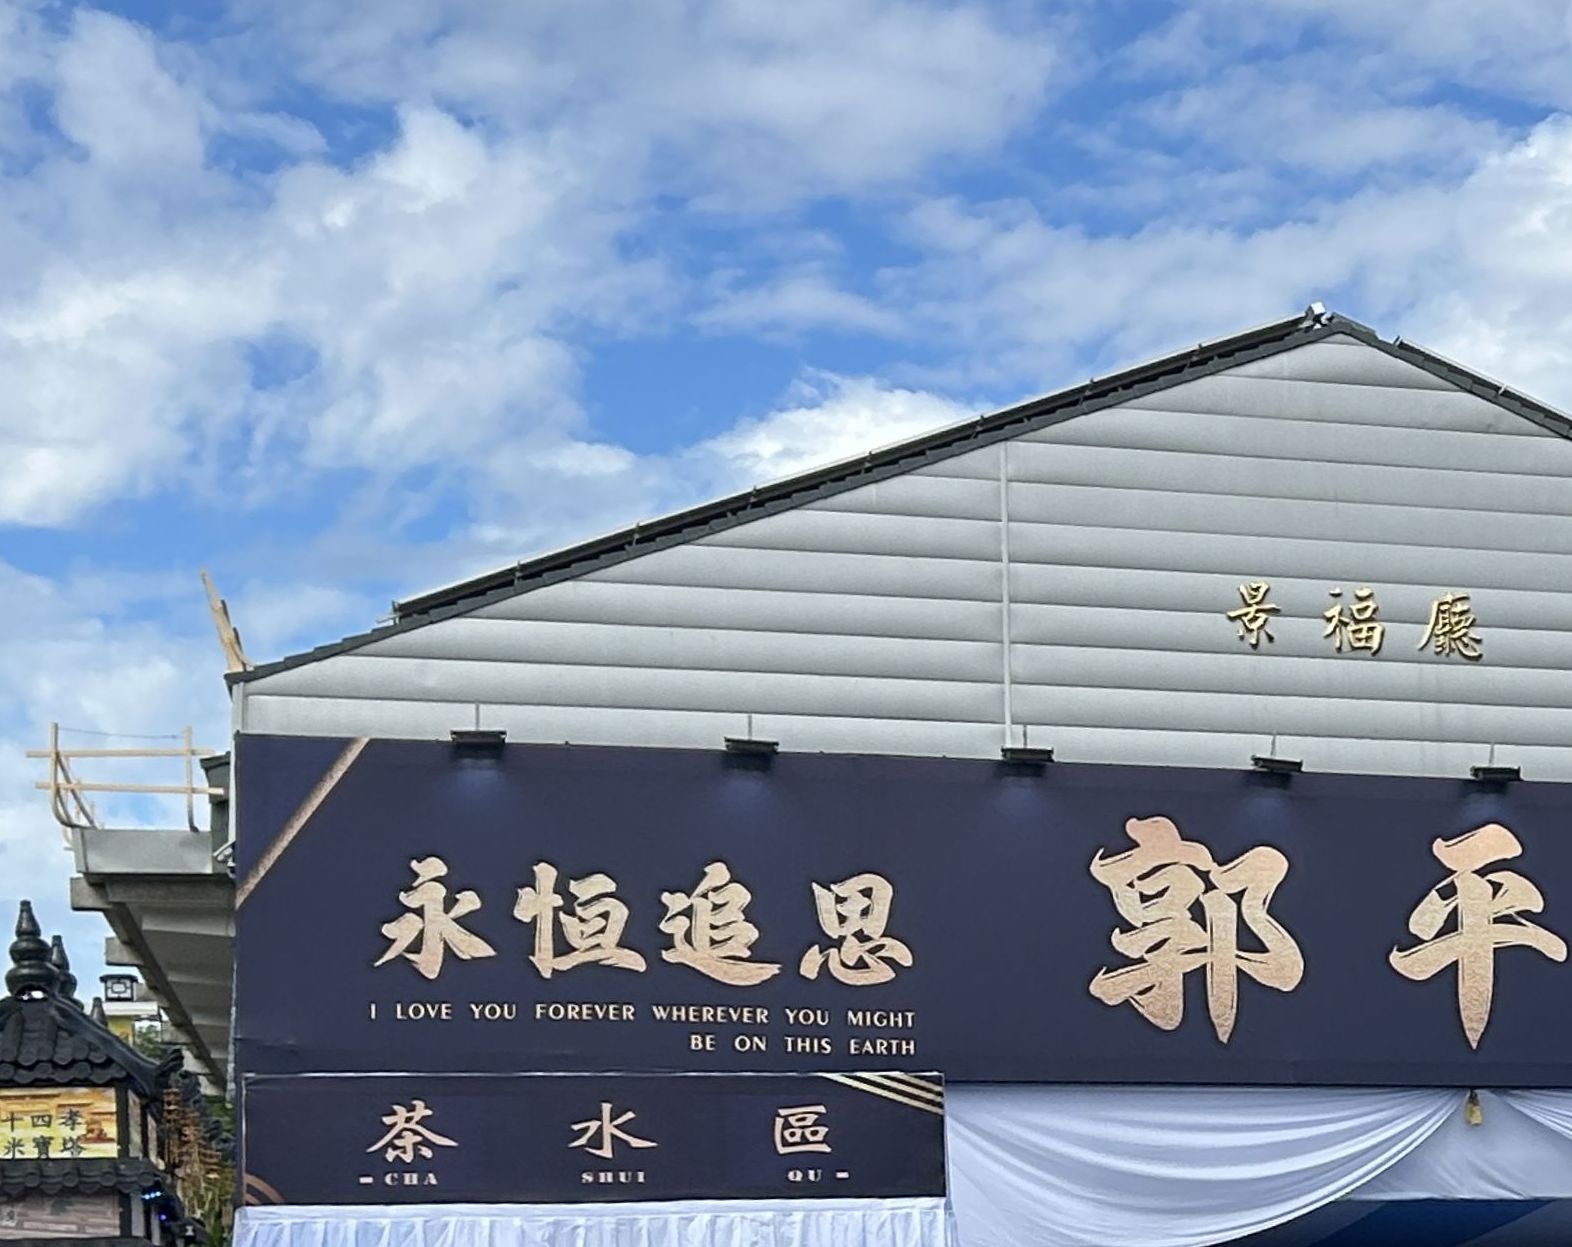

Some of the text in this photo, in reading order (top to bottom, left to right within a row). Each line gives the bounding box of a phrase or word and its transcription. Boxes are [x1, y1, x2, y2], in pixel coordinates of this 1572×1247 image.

[1227, 581, 1484, 662] 景福廳
[369, 1002, 916, 1029] I LOVE YOU FOREVER WHEREVER YOU MIGHT
[689, 1033, 916, 1057] BE ON THIS EARTH
[366, 1099, 832, 1165] 茶水區
[383, 1168, 823, 1187] CHA SHUI QU
